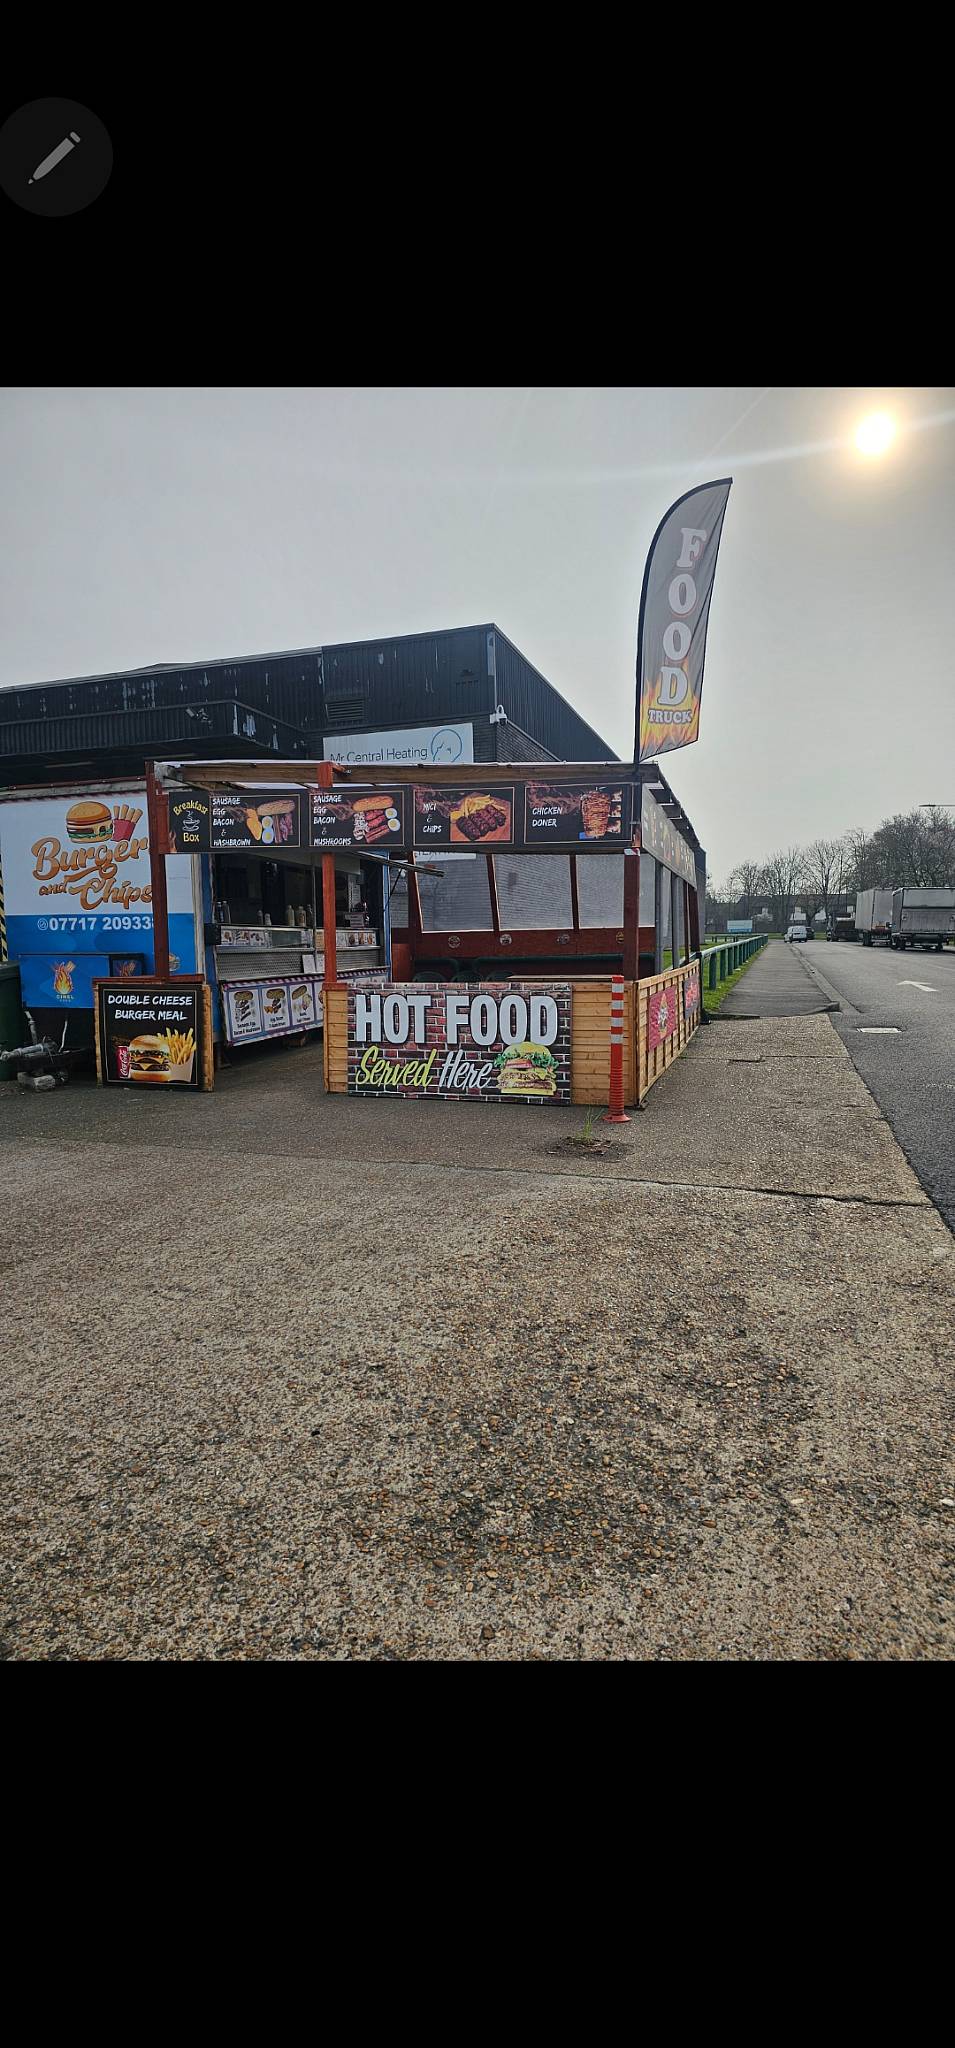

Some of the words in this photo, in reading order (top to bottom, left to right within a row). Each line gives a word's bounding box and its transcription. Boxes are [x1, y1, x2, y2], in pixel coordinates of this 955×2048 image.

[657, 527, 707, 706] FOOD
[648, 708, 693, 724] TRUCK
[330, 752, 345, 762] Mr
[346, 748, 384, 762] Central
[386, 746, 428, 761] Heating
[212, 797, 241, 806] SAUSAGE
[313, 794, 342, 804] SAUSAGE
[173, 800, 208, 816] Breakfast
[212, 808, 226, 816] EGG
[313, 806, 327, 814] EGG
[532, 806, 563, 816] CHICKEN
[213, 818, 235, 826] BACON
[313, 816, 336, 825] BACON
[532, 818, 557, 828] DONER
[422, 825, 442, 833] CHIPS
[183, 832, 200, 843] Box
[213, 838, 251, 847] HASHBROWN
[313, 837, 352, 846] MUSHROOMS
[31, 837, 149, 881] Burger
[39, 882, 67, 896] and
[68, 877, 152, 911] Chips
[50, 917, 97, 931] 07717
[102, 916, 153, 931] 20933
[108, 995, 149, 1006] DOUBLE
[151, 995, 193, 1006] CHEESE
[114, 1009, 157, 1021] BURGER
[158, 1010, 188, 1022] MEAL
[355, 993, 432, 1044] HOT
[446, 993, 558, 1046] FOOD
[355, 1045, 438, 1088] Served
[439, 1049, 494, 1090] Here
